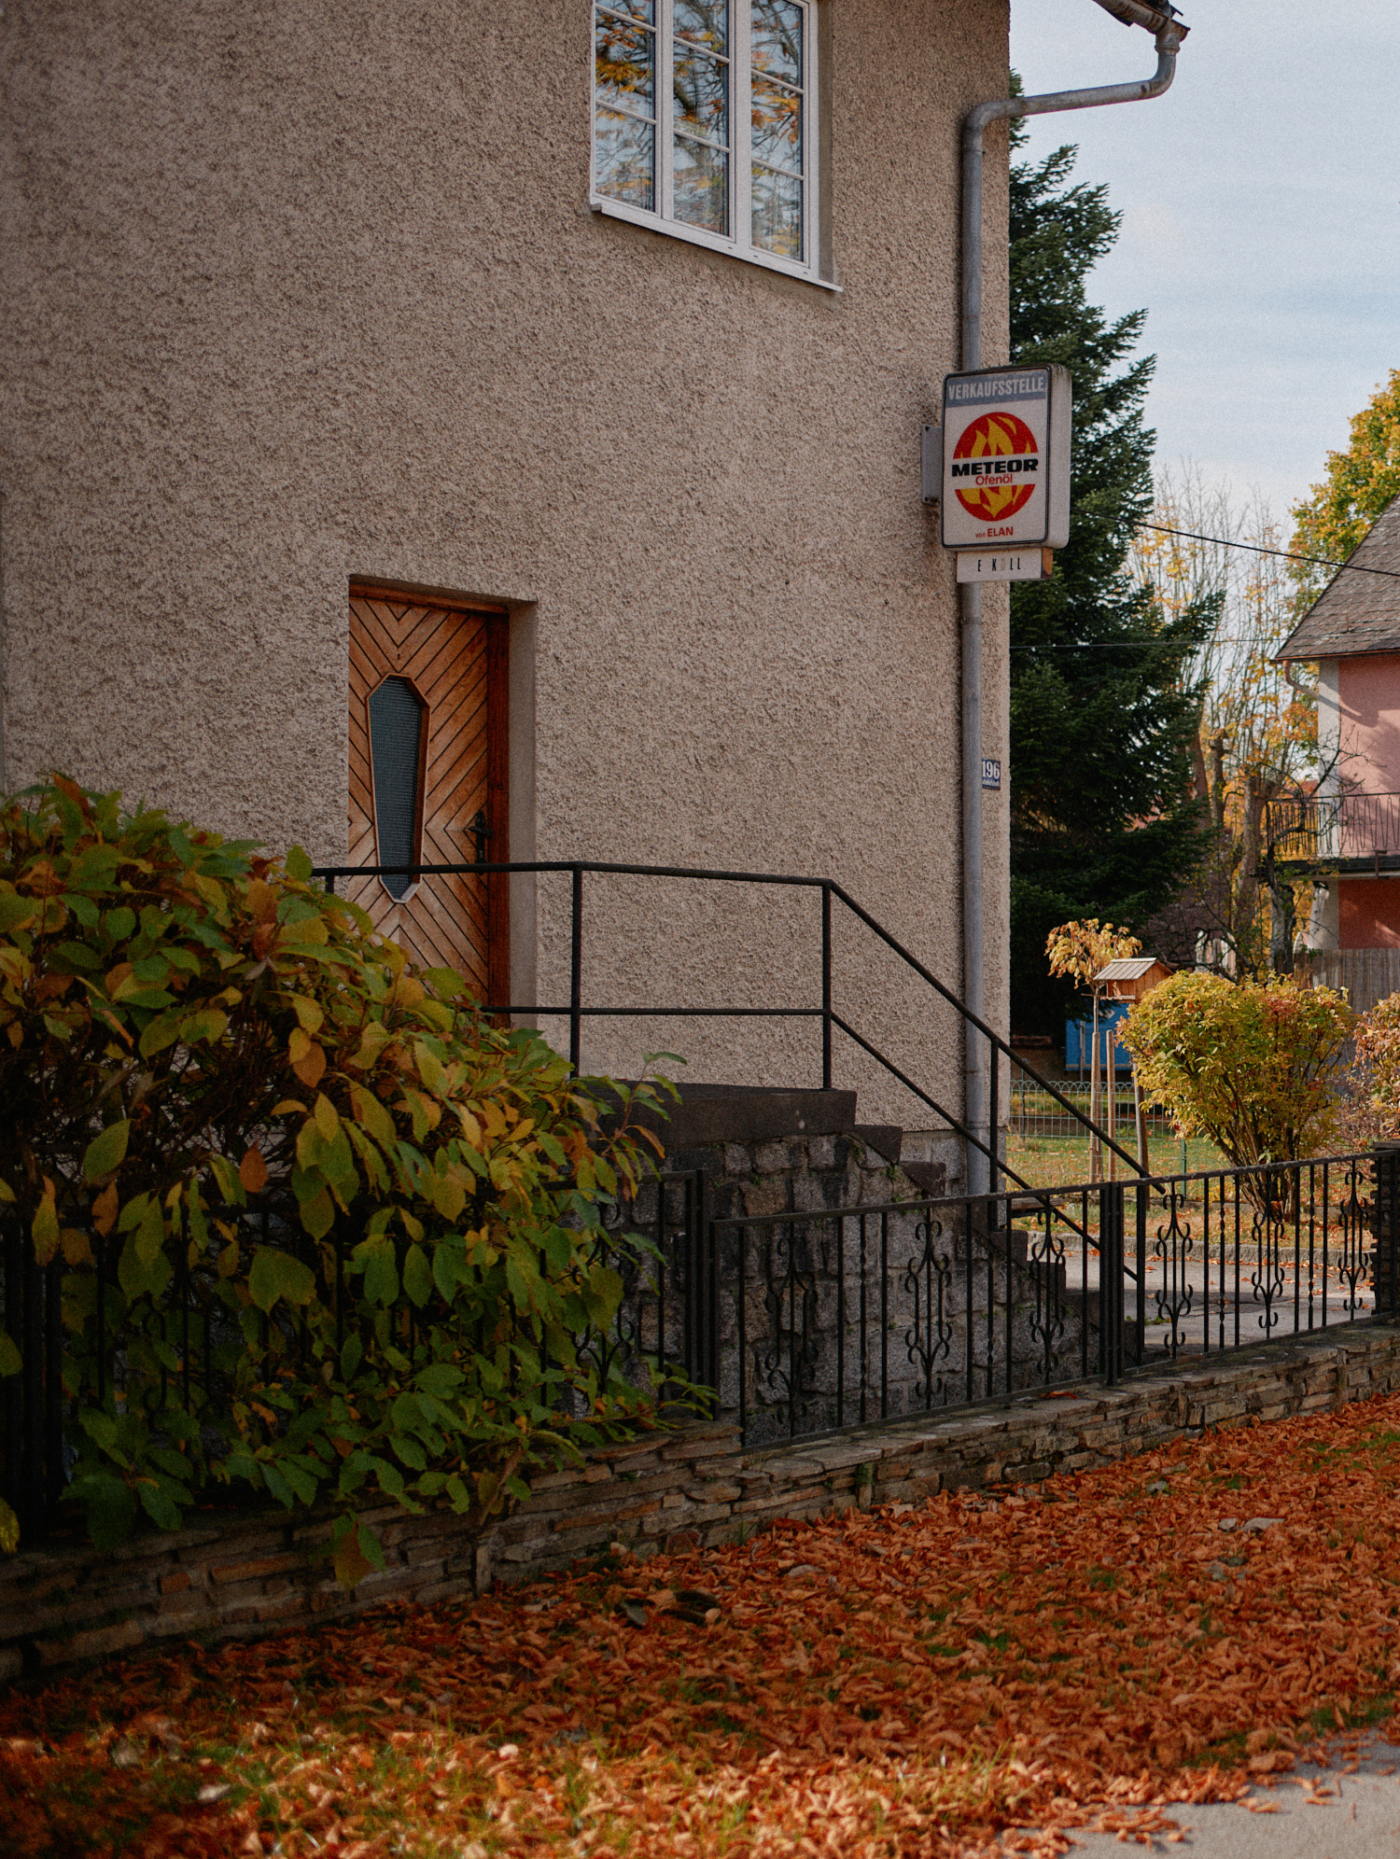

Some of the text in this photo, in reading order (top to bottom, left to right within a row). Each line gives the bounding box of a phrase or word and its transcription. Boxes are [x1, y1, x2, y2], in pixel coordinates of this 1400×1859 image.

[949, 376, 1044, 399] VERKAUFSSTELLE
[952, 458, 1039, 477] METEOR
[975, 473, 1013, 486] Ofenöl
[987, 527, 1014, 538] ELAN
[982, 761, 999, 779] 196
